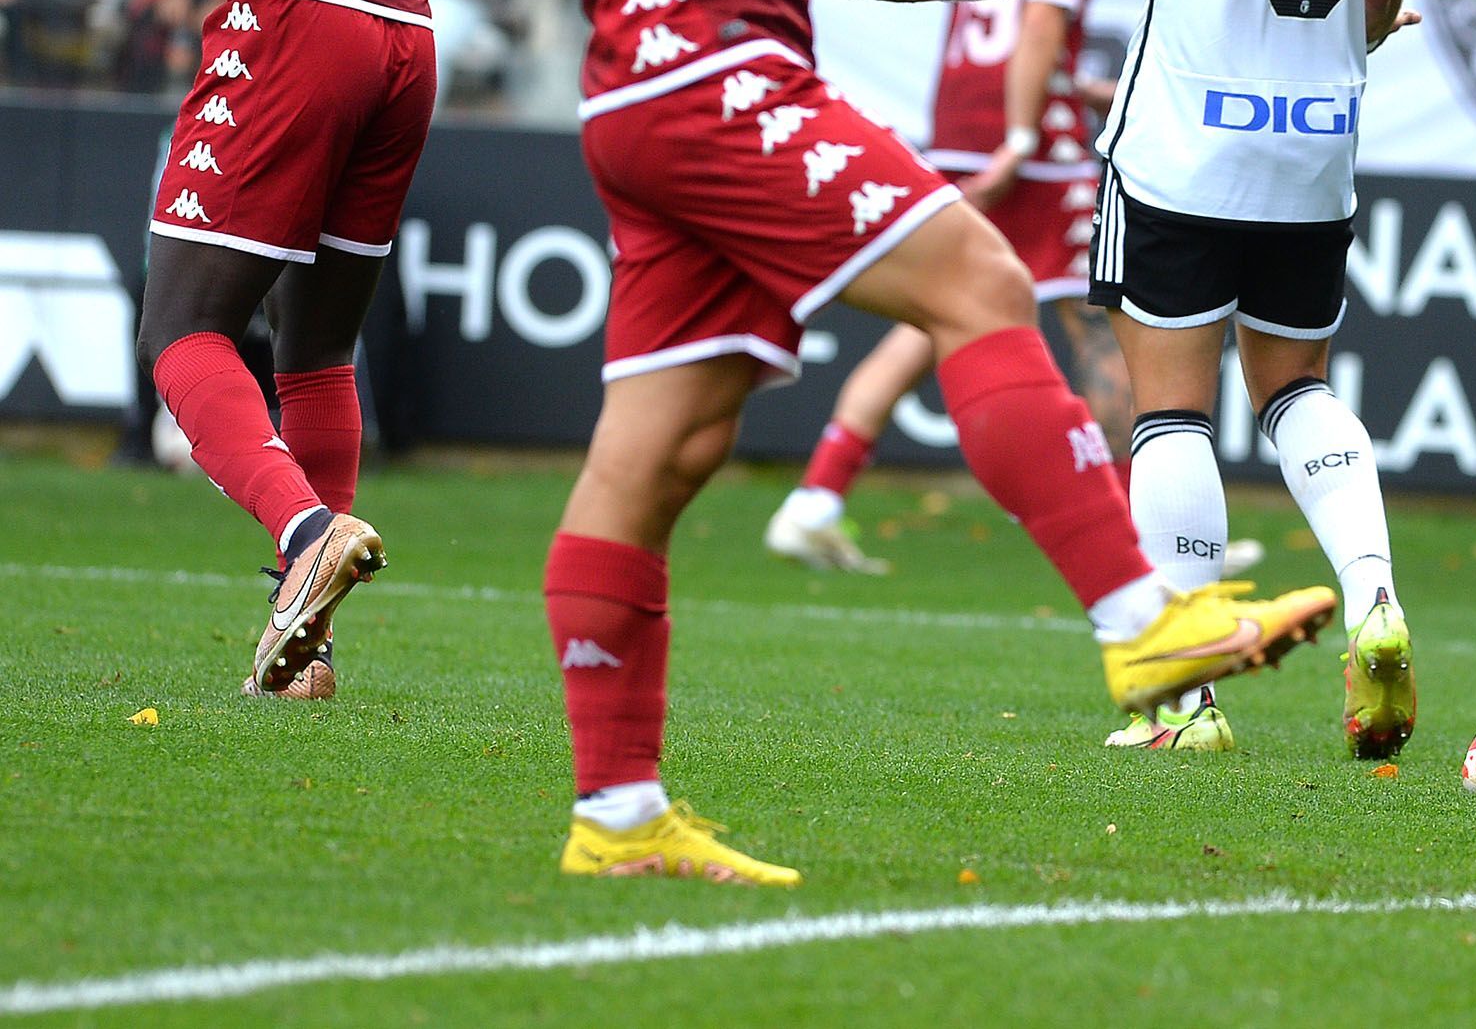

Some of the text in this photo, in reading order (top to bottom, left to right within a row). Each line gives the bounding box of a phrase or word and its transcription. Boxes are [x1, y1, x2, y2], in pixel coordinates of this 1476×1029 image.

[1203, 89, 1358, 134] DIGI
[1304, 451, 1360, 477] BCF
[1176, 536, 1222, 560] BCF
